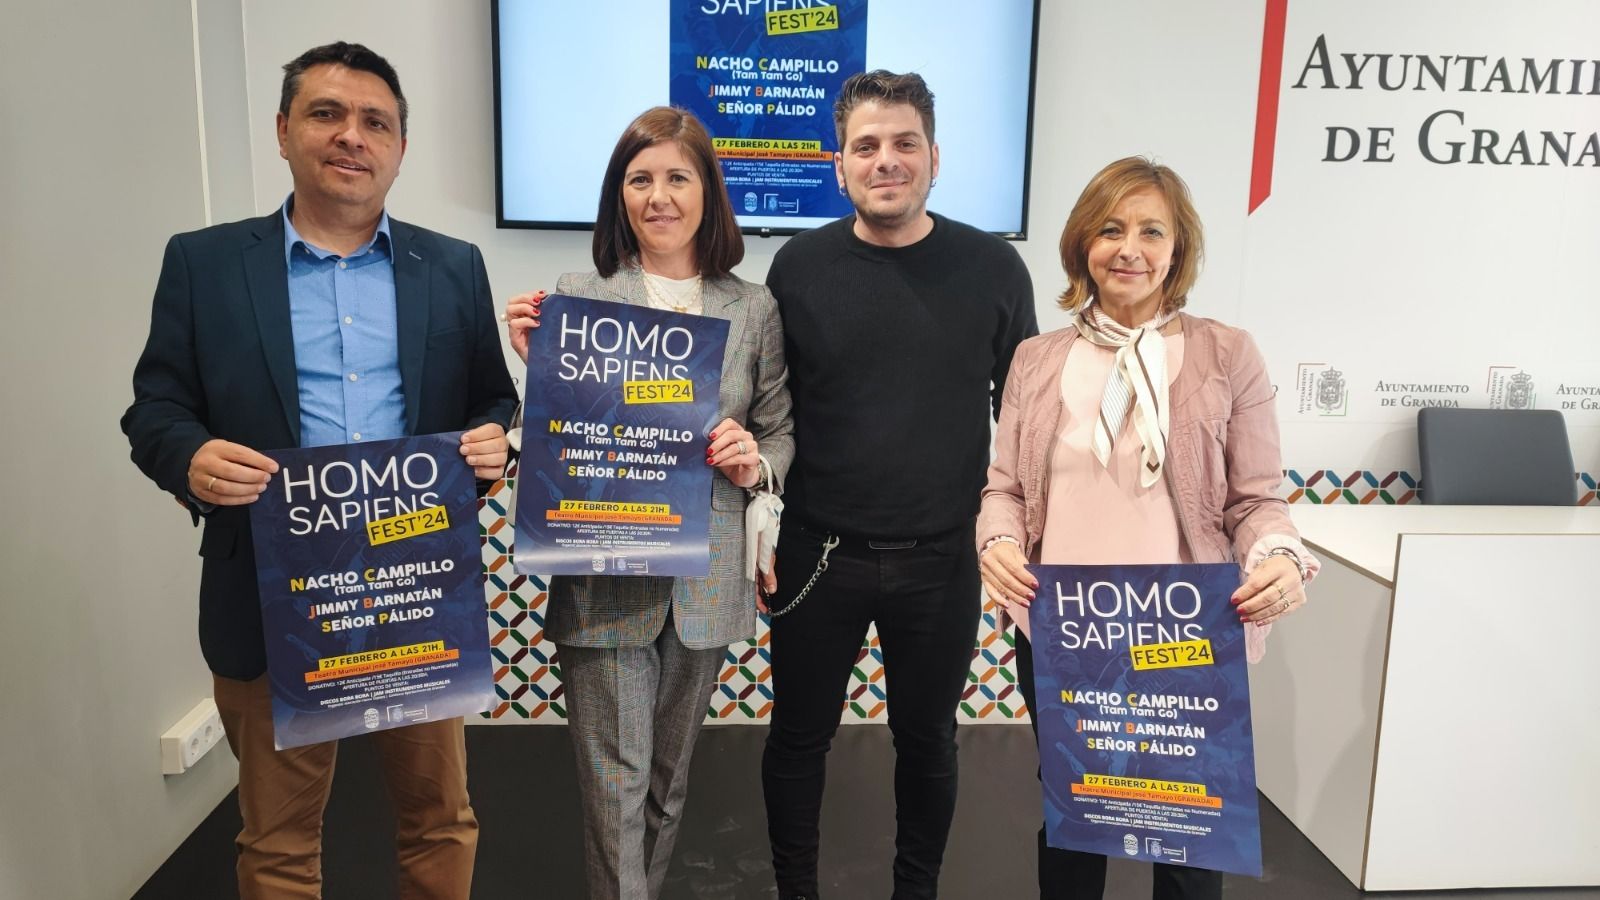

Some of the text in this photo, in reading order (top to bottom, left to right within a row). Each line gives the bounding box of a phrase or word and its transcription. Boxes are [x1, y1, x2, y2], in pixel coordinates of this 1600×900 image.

[768, 10, 836, 31] FEST'24
[696, 56, 839, 73] NACHO CAMPILLO
[732, 70, 803, 82] (Tam Tam Go)
[708, 85, 825, 99] JIMMY BARNATÁN
[718, 101, 816, 116] SEÑOR PÁLIDO
[729, 140, 771, 149] FEBRERO
[781, 141, 798, 149] LAS
[1321, 126, 1395, 163] DE
[560, 313, 694, 361] HOMO
[626, 384, 691, 400] FEST'24
[1375, 379, 1470, 394] AYUNTAMIENTO
[549, 419, 694, 443] NACHO CAMPILLO
[585, 435, 657, 449] (Tam Tam Go)
[559, 448, 678, 466] JIMMY BARNATÁN
[283, 452, 438, 503] HOMO
[568, 464, 667, 481] SEÑOR PÁLIDO
[578, 503, 619, 511] FEBRERO
[631, 505, 648, 513] LAS
[370, 510, 446, 541] FEST'24
[290, 559, 454, 592] NACHO CAMPILLO
[334, 576, 416, 596] (Tam Tam Go)
[308, 587, 443, 619] JIMMY BARNATÁN
[1056, 581, 1202, 619] HOMO
[321, 606, 434, 633] SEÑOR PÁLIDO
[324, 643, 442, 668] 27 FEBRERO A LAS 21H.
[1133, 644, 1211, 666] FEST'24
[1061, 690, 1219, 712] NACHO CAMPILLO
[1100, 705, 1178, 719] (Tam Tam Go)
[1076, 719, 1206, 739] JIMMY BARNATÁN
[1087, 736, 1197, 757] SEÑOR PÁLIDO
[1102, 777, 1147, 789] FEBRERO
[1160, 784, 1180, 792] LAS
